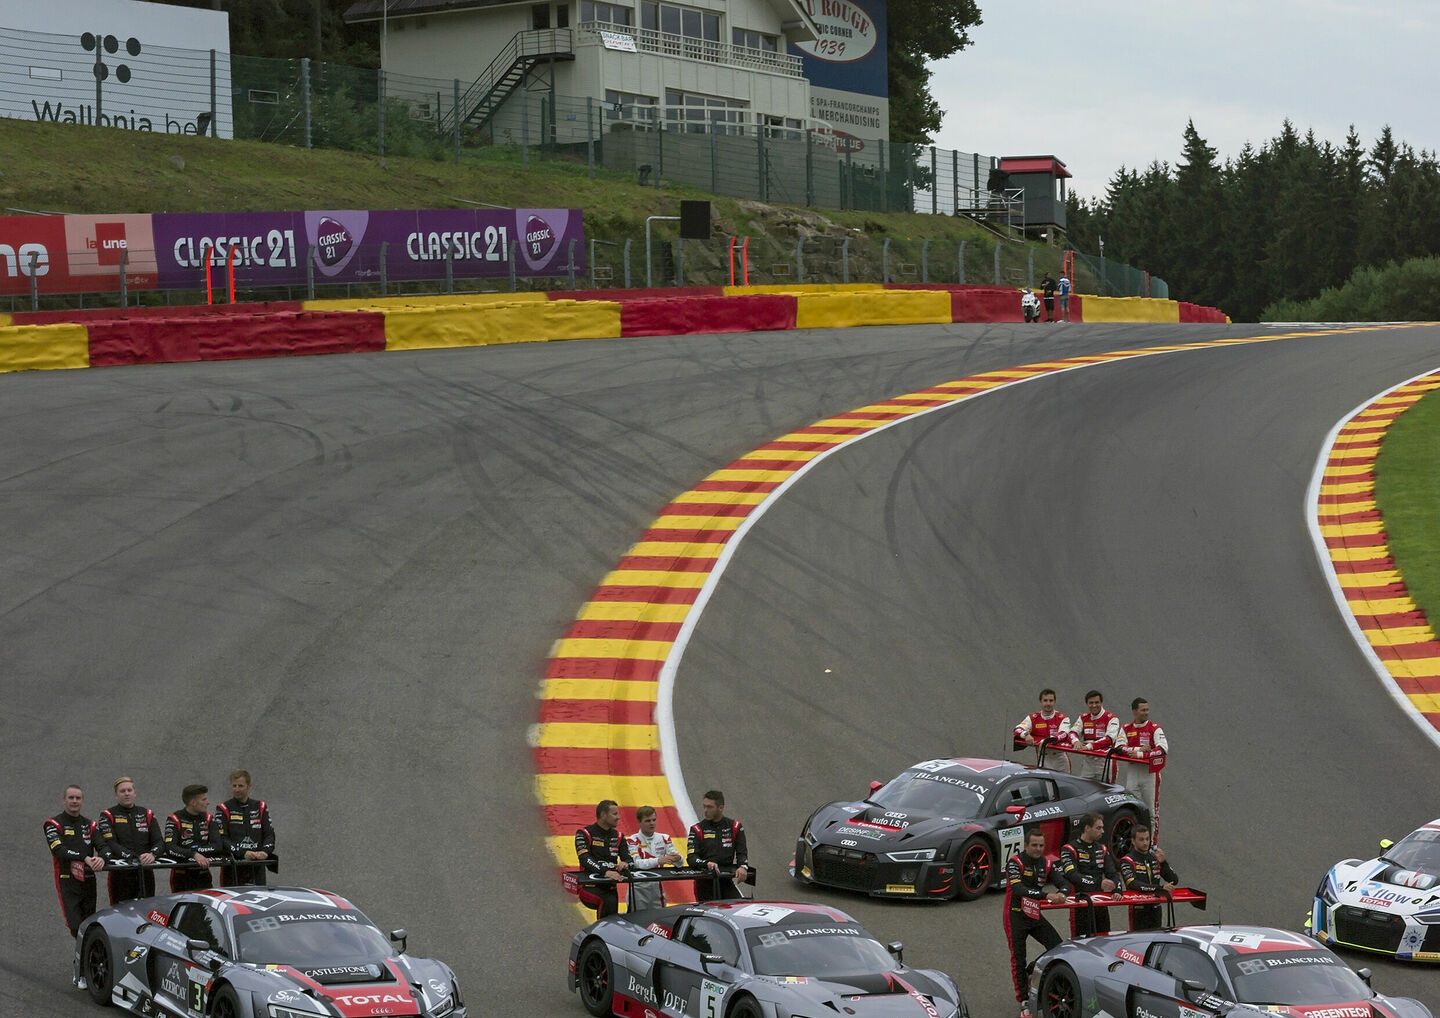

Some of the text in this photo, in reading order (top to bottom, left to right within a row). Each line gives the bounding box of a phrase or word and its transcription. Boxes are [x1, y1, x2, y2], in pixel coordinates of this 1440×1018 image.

[830, 25, 853, 39] CORNER
[814, 39, 846, 57] 1939
[816, 98, 880, 116] SPA-FRANCORCHAMPS
[818, 109, 880, 128] MERCHANDISING
[318, 231, 347, 247] CLASSIC
[526, 228, 551, 244] CLASSIC
[86, 237, 128, 250] la une
[174, 229, 298, 269] CLASSIC 21
[407, 225, 508, 262] CLASSIC 21
[532, 243, 542, 256] 21
[326, 246, 336, 259] 21
[916, 772, 989, 795] BLANCPAIN
[1034, 809, 1047, 818] auto
[872, 816, 888, 825] auto
[1361, 897, 1392, 907] TOTAL
[1373, 887, 1411, 905] flow
[1022, 899, 1039, 909] TOTAL
[150, 911, 165, 925] TOTAL
[278, 914, 358, 923] BLANCPAIN
[752, 908, 774, 917] 5
[650, 923, 668, 938] TOTAL
[788, 928, 860, 936] BLANCPAIN
[1229, 935, 1247, 943] 6
[1120, 949, 1140, 965] TOTAL
[1266, 957, 1334, 967] BLANCPAIN
[305, 965, 369, 978] CASTLESTONE
[194, 984, 201, 1011] 3
[336, 994, 413, 1007] TOTAL
